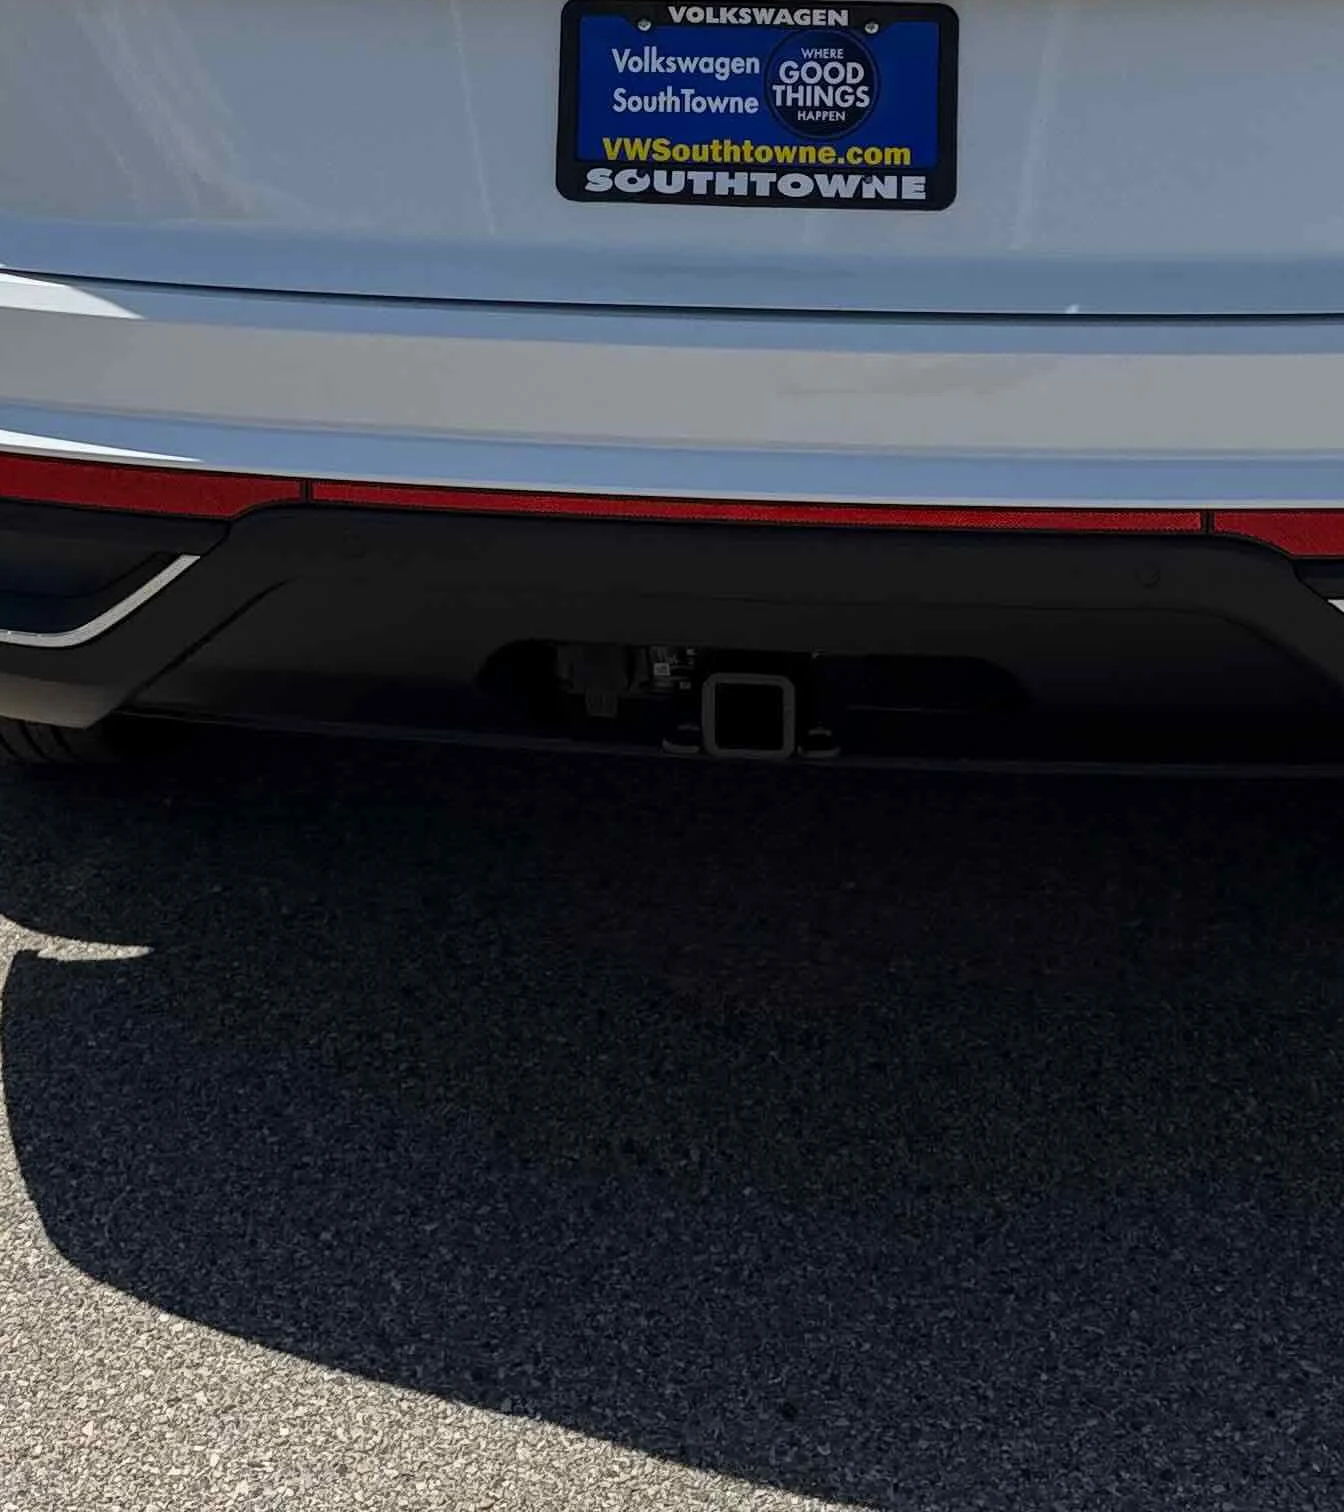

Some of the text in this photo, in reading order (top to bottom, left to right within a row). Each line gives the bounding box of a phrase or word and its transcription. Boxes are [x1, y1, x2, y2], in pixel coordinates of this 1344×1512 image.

[668, 6, 849, 26] VOLKSWAGEN
[612, 47, 760, 80] Volkswagen
[801, 48, 844, 59] WHERE
[778, 61, 865, 85] GOOD
[612, 86, 759, 114] SouthTowne
[772, 85, 871, 108] THINGS
[797, 110, 846, 122] HAPPEN
[602, 137, 912, 166] VWSouthtowne.com
[584, 168, 927, 200] SOUTHTOWNE
